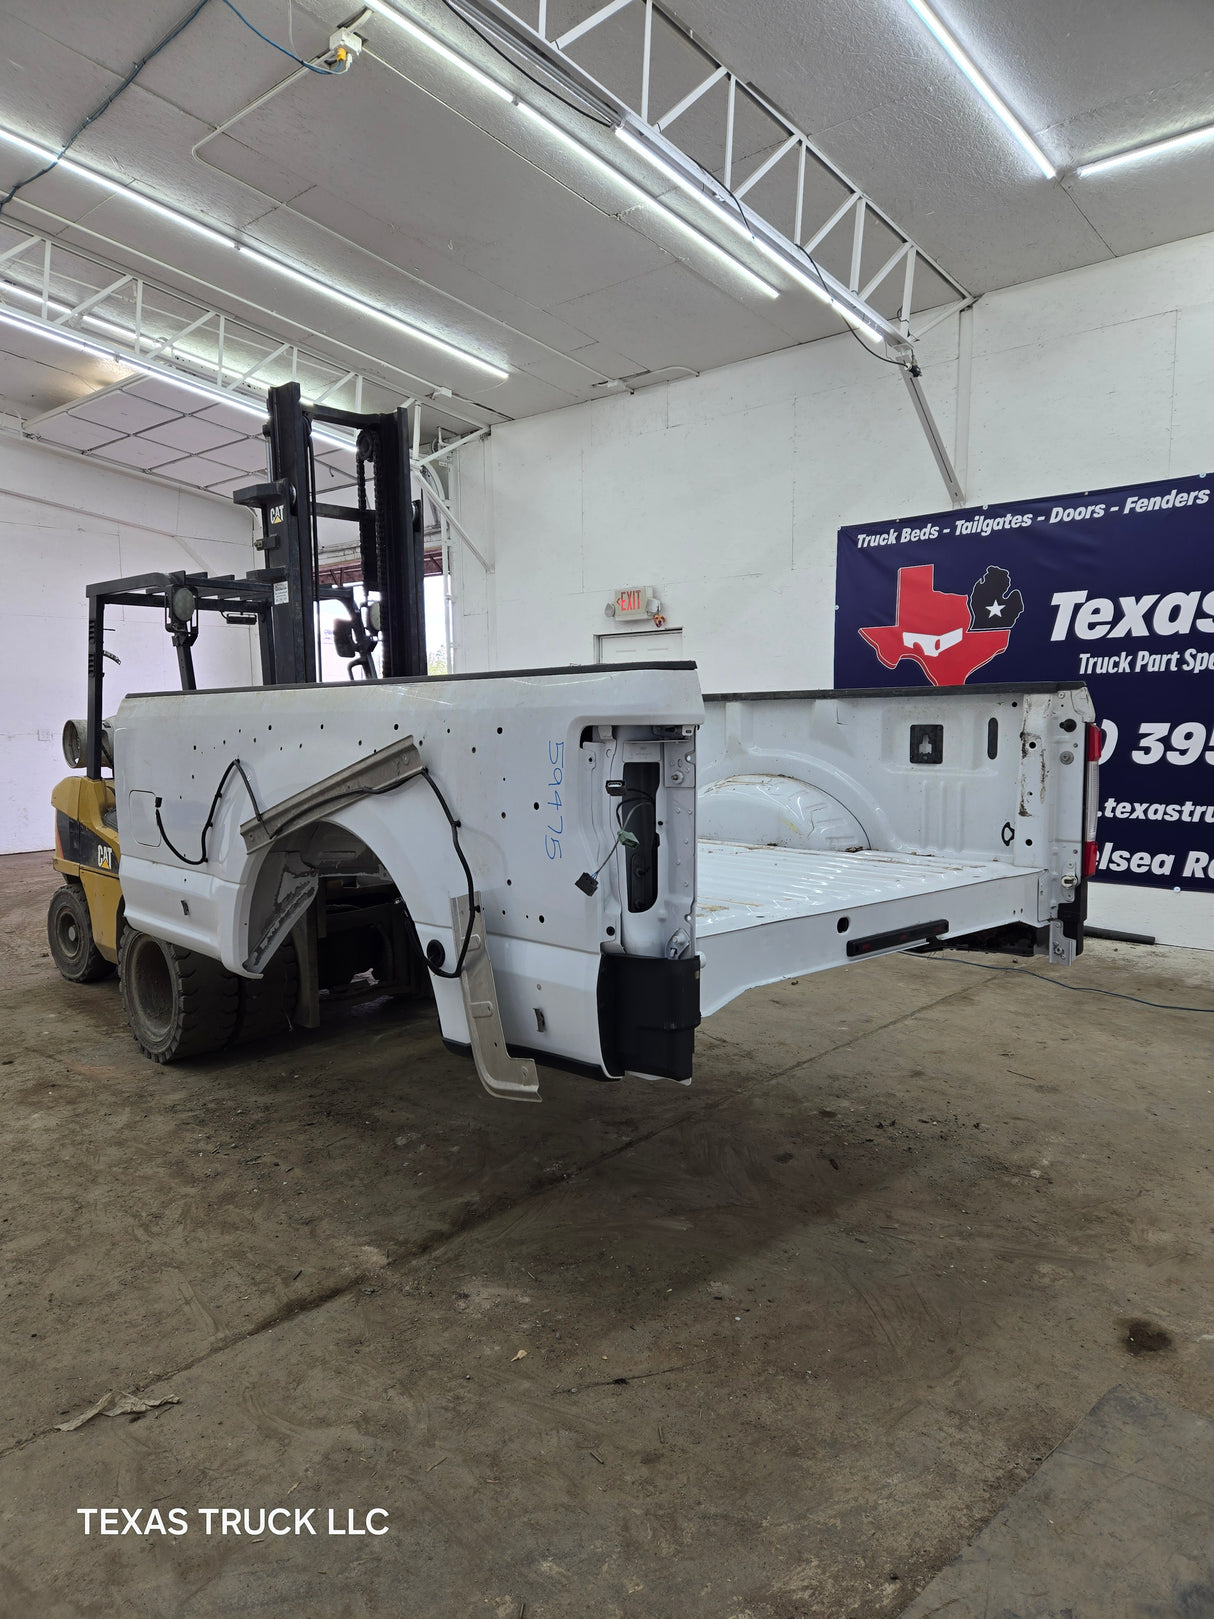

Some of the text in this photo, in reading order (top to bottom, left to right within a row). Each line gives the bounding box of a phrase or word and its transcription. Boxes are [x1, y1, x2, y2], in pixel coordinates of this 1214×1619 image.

[270, 505, 285, 524] CAT
[857, 529, 898, 548] Truck
[900, 523, 939, 543] Beds
[955, 512, 1033, 536] Tailgates
[1049, 504, 1106, 524] Doors
[1123, 489, 1211, 514] Fenders
[620, 590, 641, 611] EXIT
[1079, 651, 1133, 675] Truck
[1135, 650, 1180, 672] Part
[1131, 722, 1214, 766] 39
[97, 844, 112, 870] CAT
[1096, 842, 1175, 876] lsea
